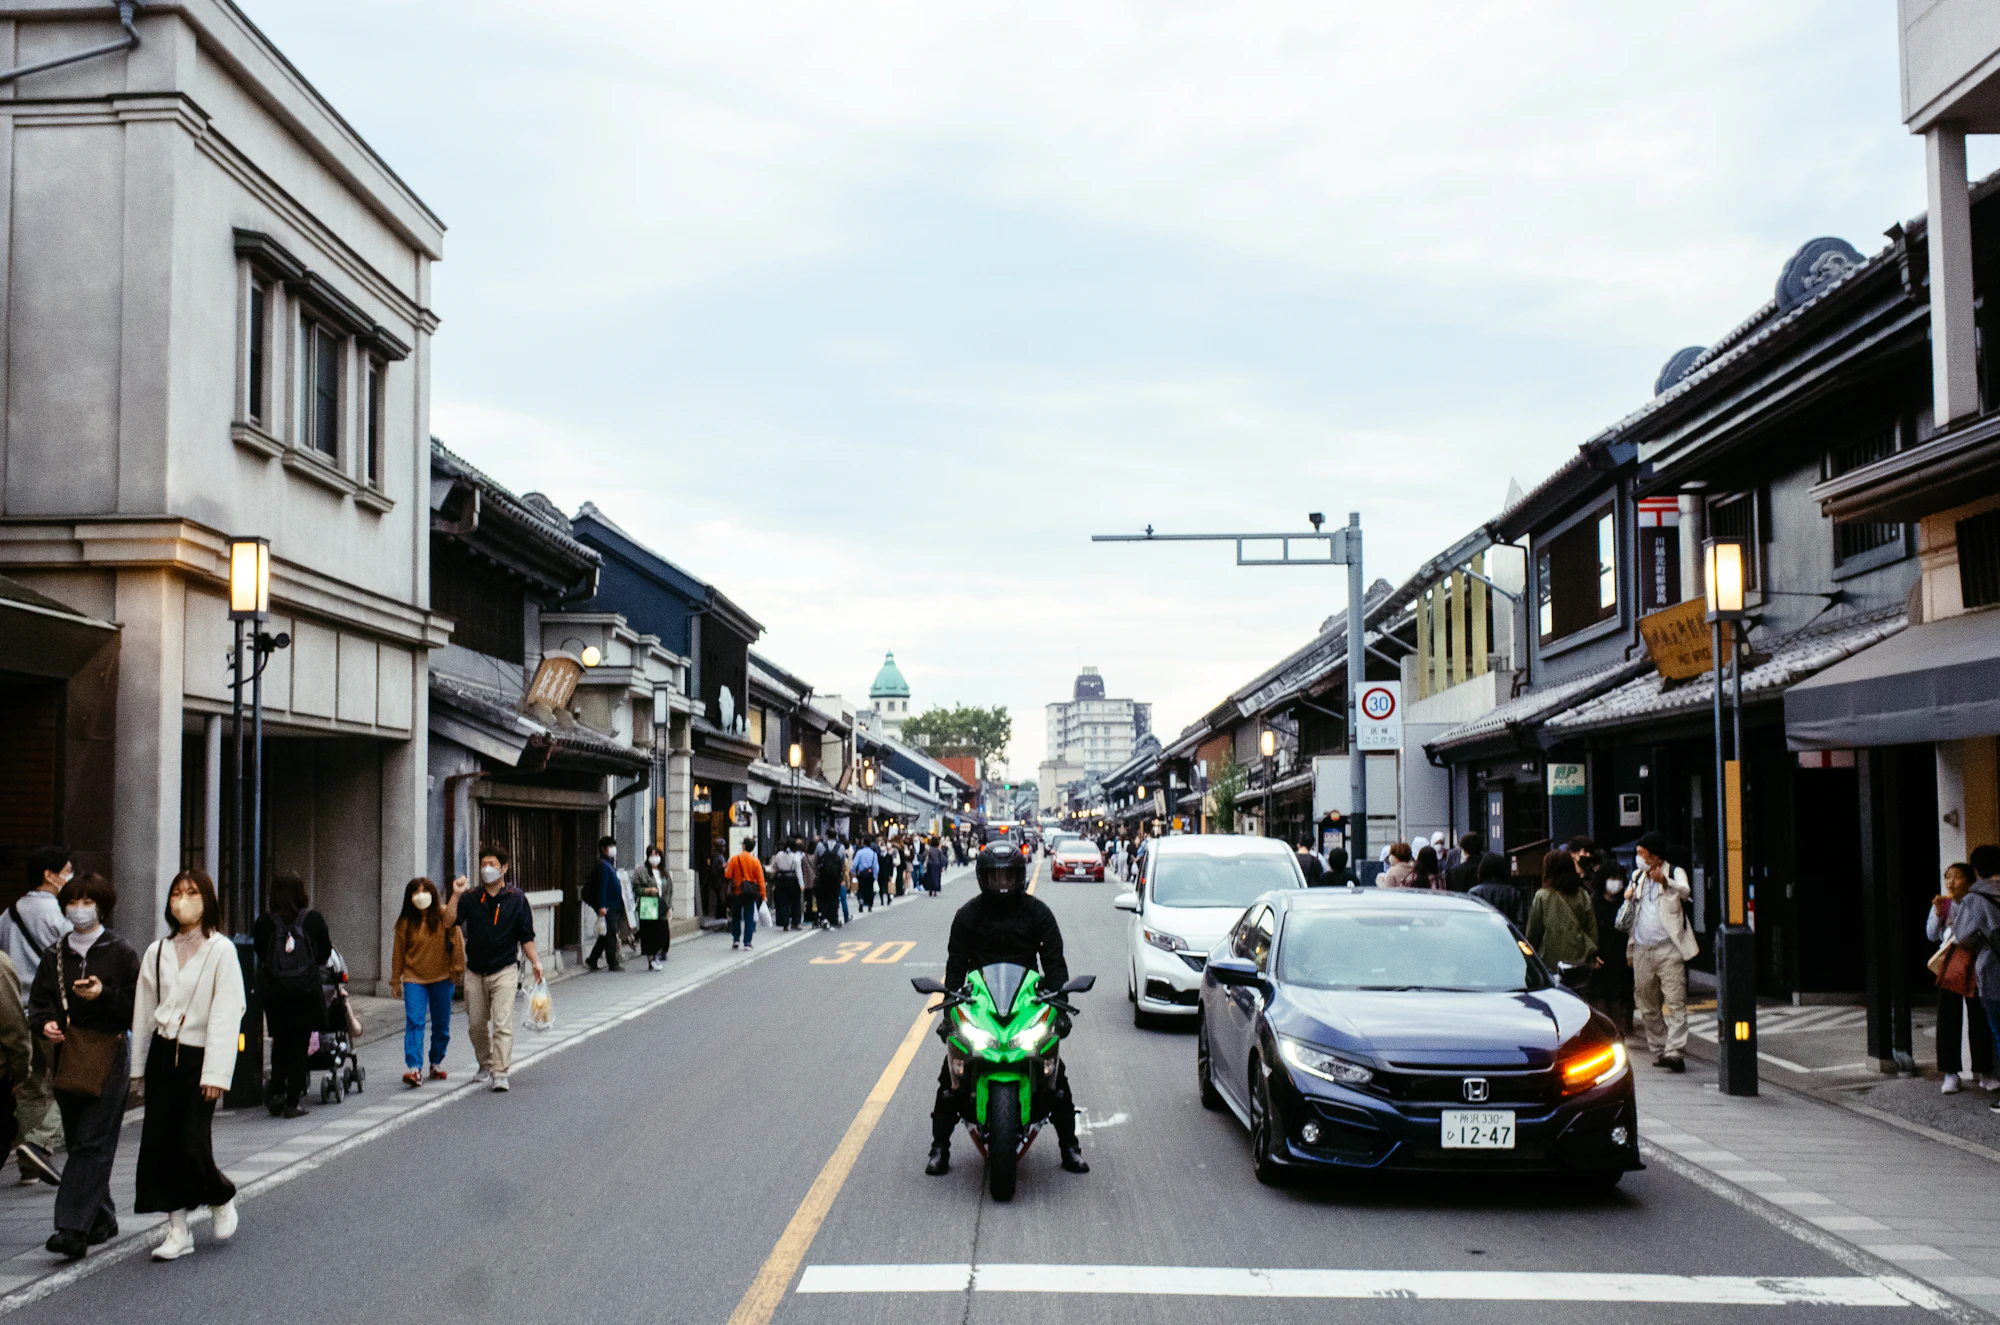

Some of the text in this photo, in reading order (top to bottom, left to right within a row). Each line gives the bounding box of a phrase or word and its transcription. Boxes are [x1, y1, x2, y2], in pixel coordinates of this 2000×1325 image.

[1370, 696, 1388, 711] 30
[808, 941, 917, 964] 30
[1482, 1113, 1500, 1124] 330
[1461, 1126, 1511, 1145] 12-47
